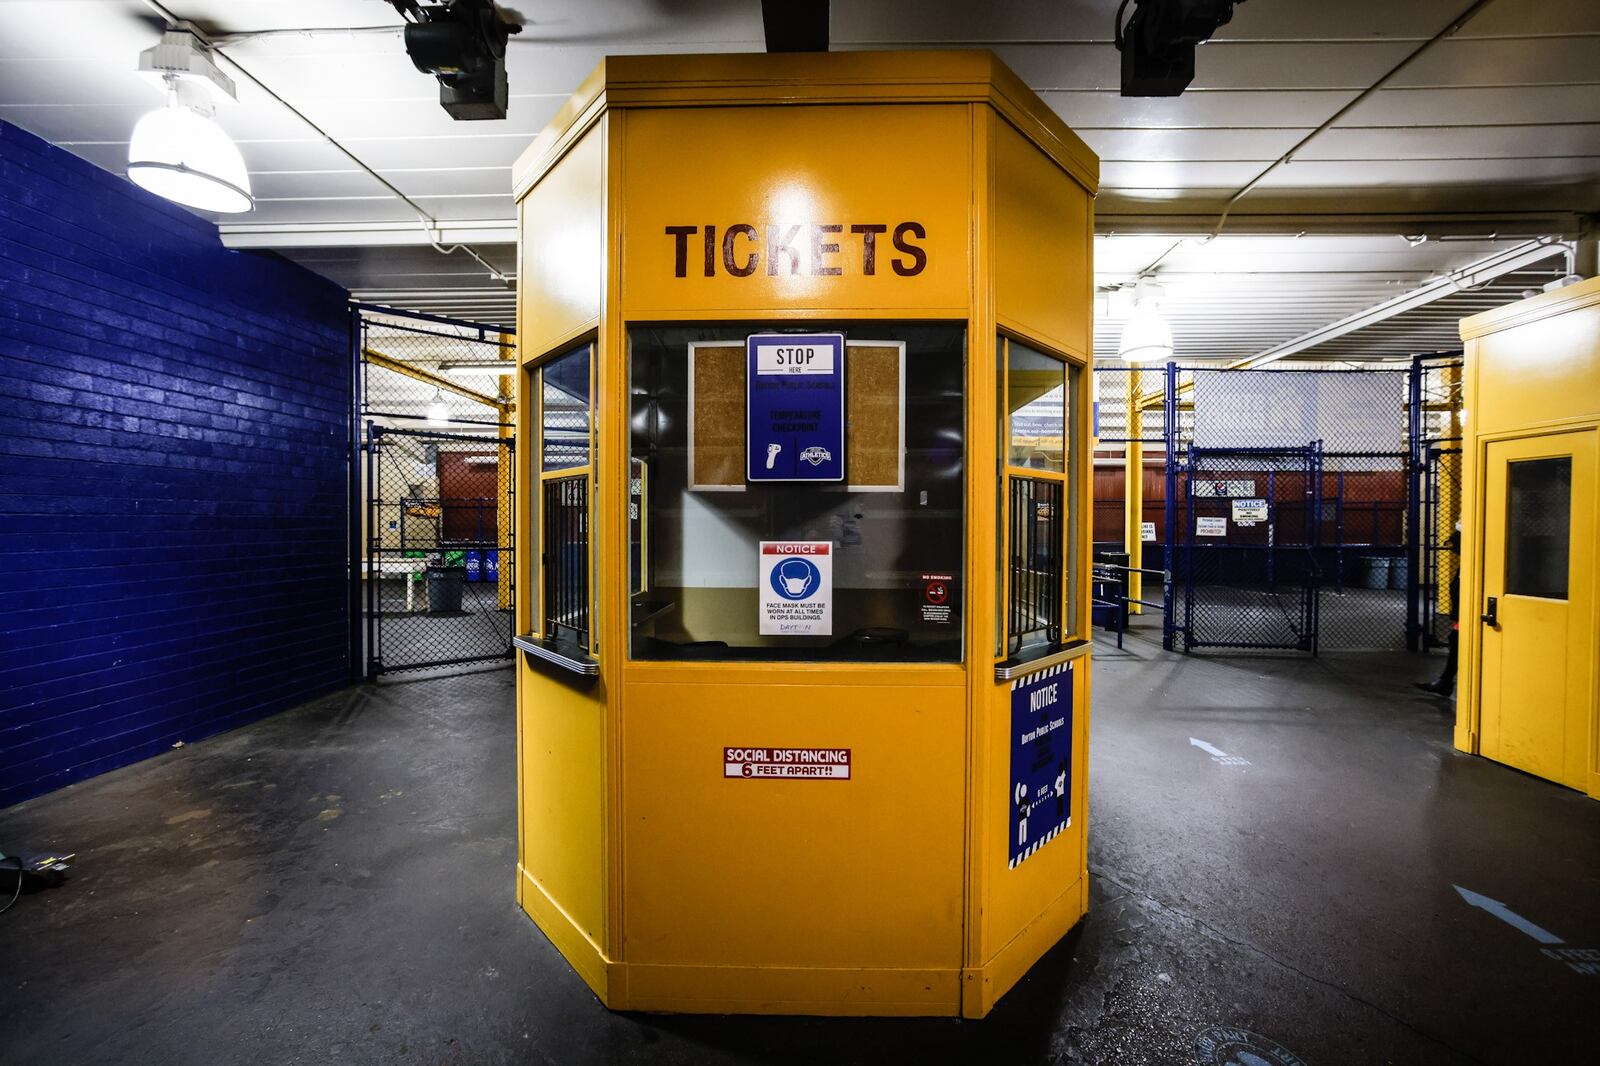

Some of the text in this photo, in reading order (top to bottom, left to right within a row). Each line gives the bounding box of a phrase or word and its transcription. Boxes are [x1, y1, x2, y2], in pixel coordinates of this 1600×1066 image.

[665, 222, 927, 278] TICKETS
[777, 348, 815, 365] STOP
[772, 423, 818, 432] CHECKPOINT
[1234, 500, 1265, 508] NOTICE
[776, 545, 816, 554] NOTICE
[1030, 682, 1058, 713] NOTICE
[727, 749, 848, 763] SOCIAL DISTANCING
[742, 762, 833, 777] 6 FEET APART!!
